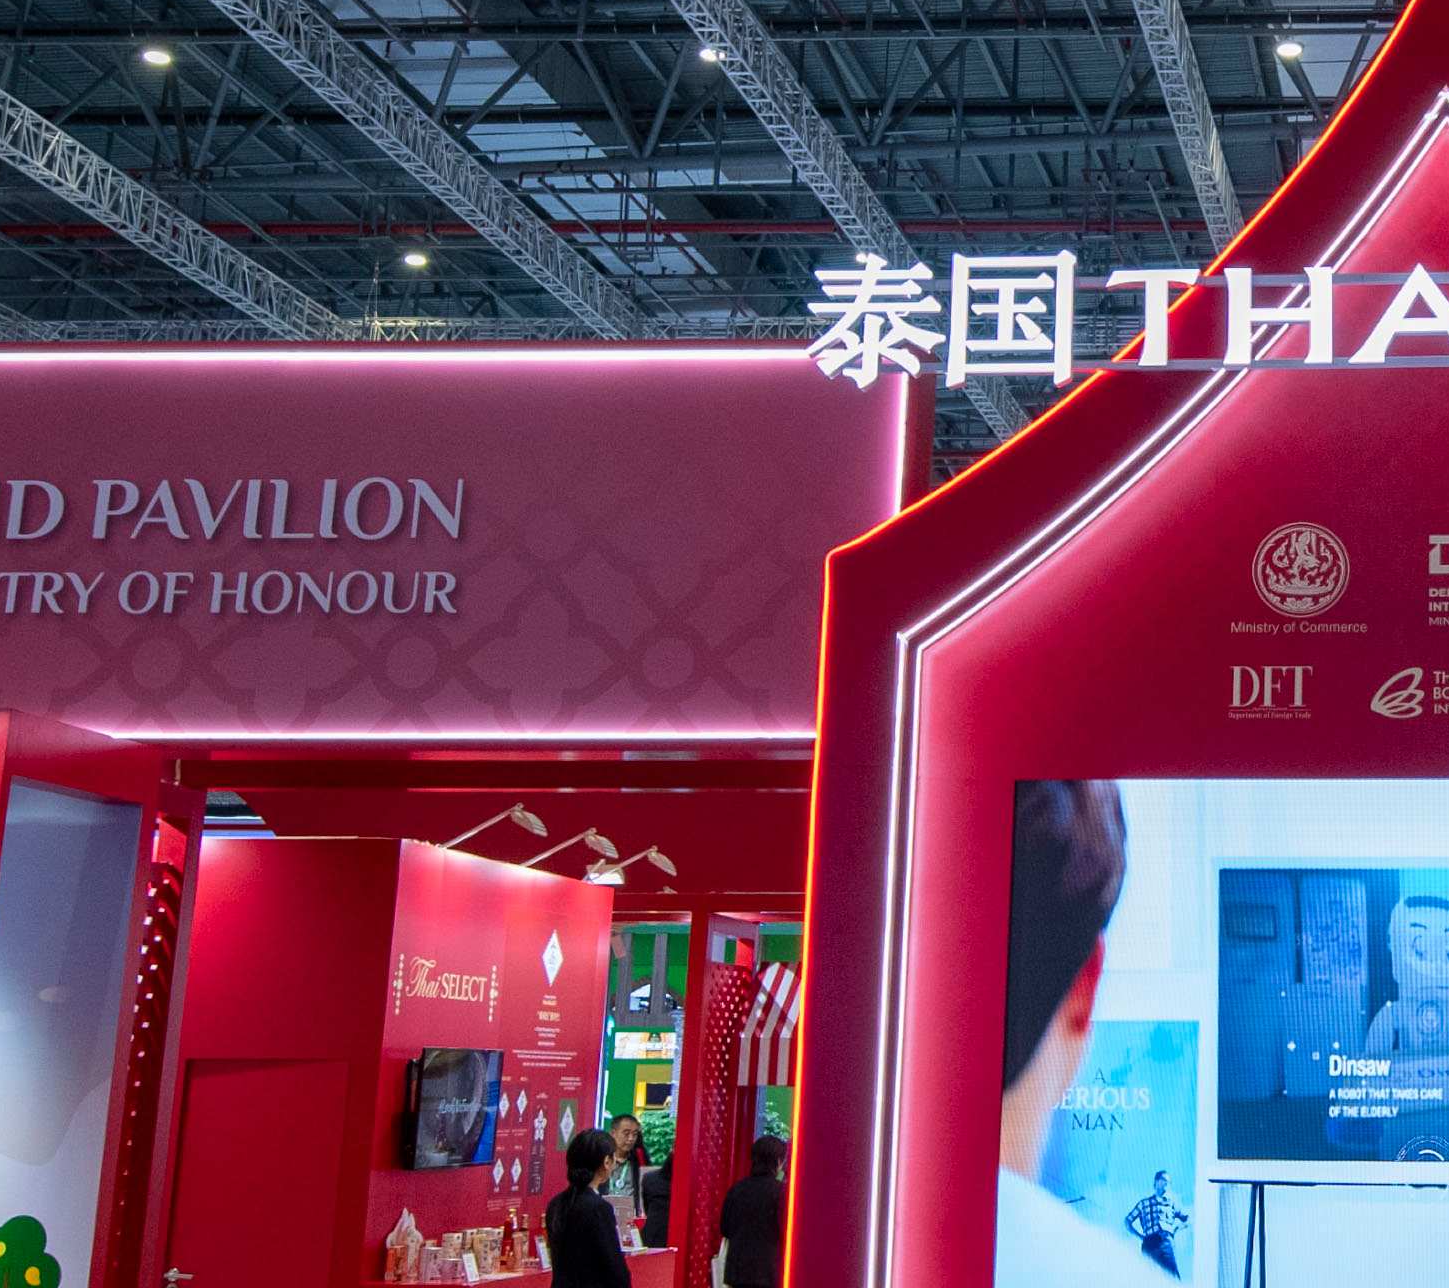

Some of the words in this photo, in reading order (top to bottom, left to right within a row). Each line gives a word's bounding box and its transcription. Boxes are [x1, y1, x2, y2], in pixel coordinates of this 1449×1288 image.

[804, 249, 1077, 391] 泰国
[92, 477, 465, 542] PAVILION
[117, 570, 195, 617] OF
[208, 570, 460, 617] HONOUR
[1230, 621, 1279, 635] Ministry
[1282, 621, 1297, 633] of
[1299, 621, 1368, 634] Commerce
[1228, 665, 1314, 709] DFT
[405, 956, 441, 999] Thai
[440, 973, 488, 1002] SELECT
[1092, 1067, 1107, 1085] A
[1328, 1054, 1391, 1077] Dinsaw
[1053, 1086, 1151, 1111] ERIOUS
[1328, 1088, 1336, 1100] A
[1338, 1088, 1367, 1100] ROBOT
[1368, 1088, 1390, 1100] THAT
[1391, 1088, 1419, 1100] TAKES
[1420, 1088, 1443, 1100] CARE
[1072, 1112, 1125, 1130] MAN
[1328, 1106, 1341, 1118] OF
[1342, 1106, 1359, 1118] THE
[1360, 1106, 1399, 1118] ELDERLY
